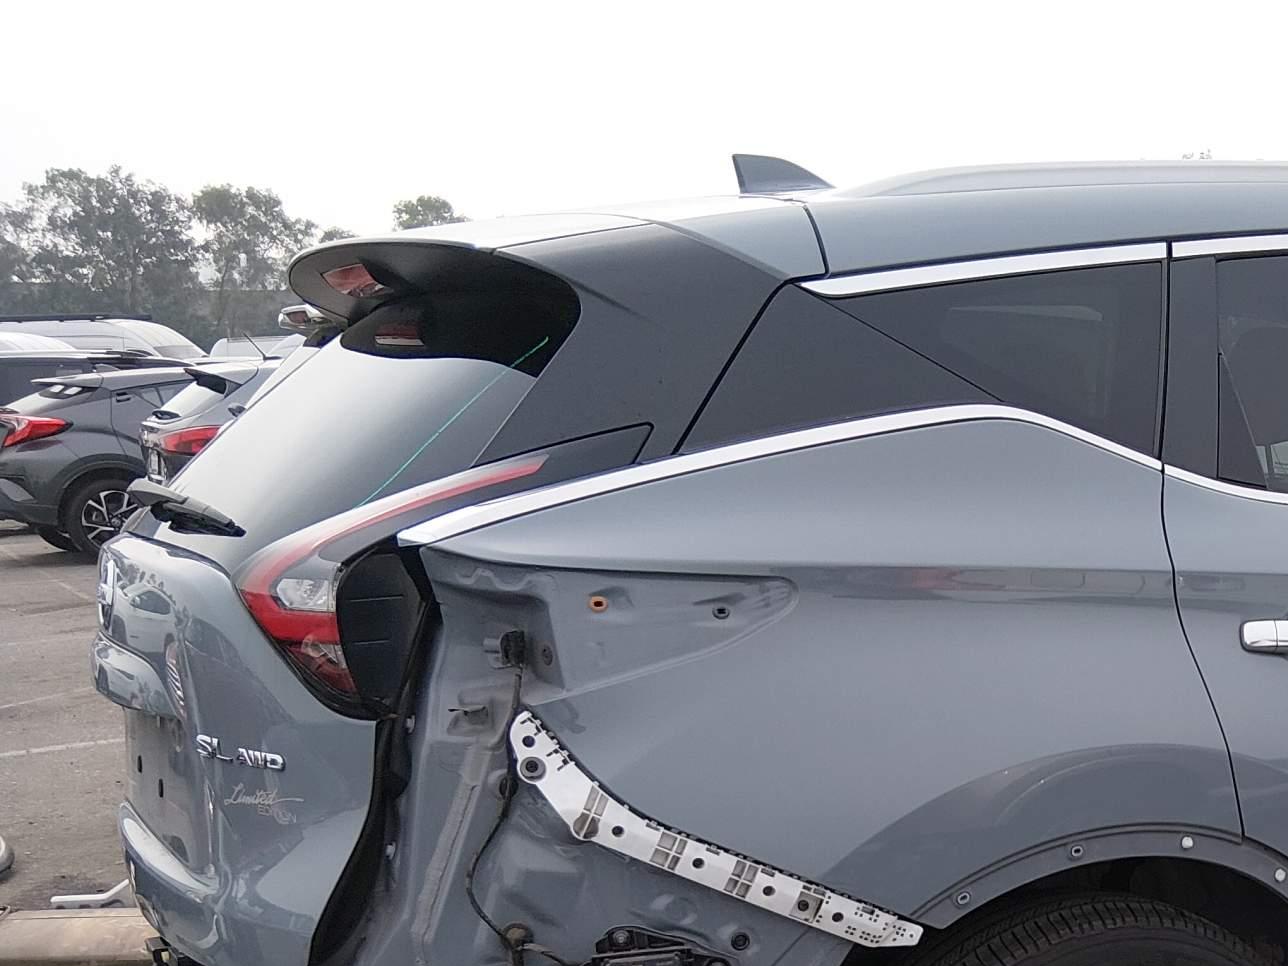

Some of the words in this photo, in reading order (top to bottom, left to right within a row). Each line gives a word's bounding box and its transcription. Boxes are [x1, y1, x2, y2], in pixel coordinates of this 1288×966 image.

[196, 734, 233, 762] SL
[237, 747, 286, 772] AWD
[223, 782, 304, 806] Limited
